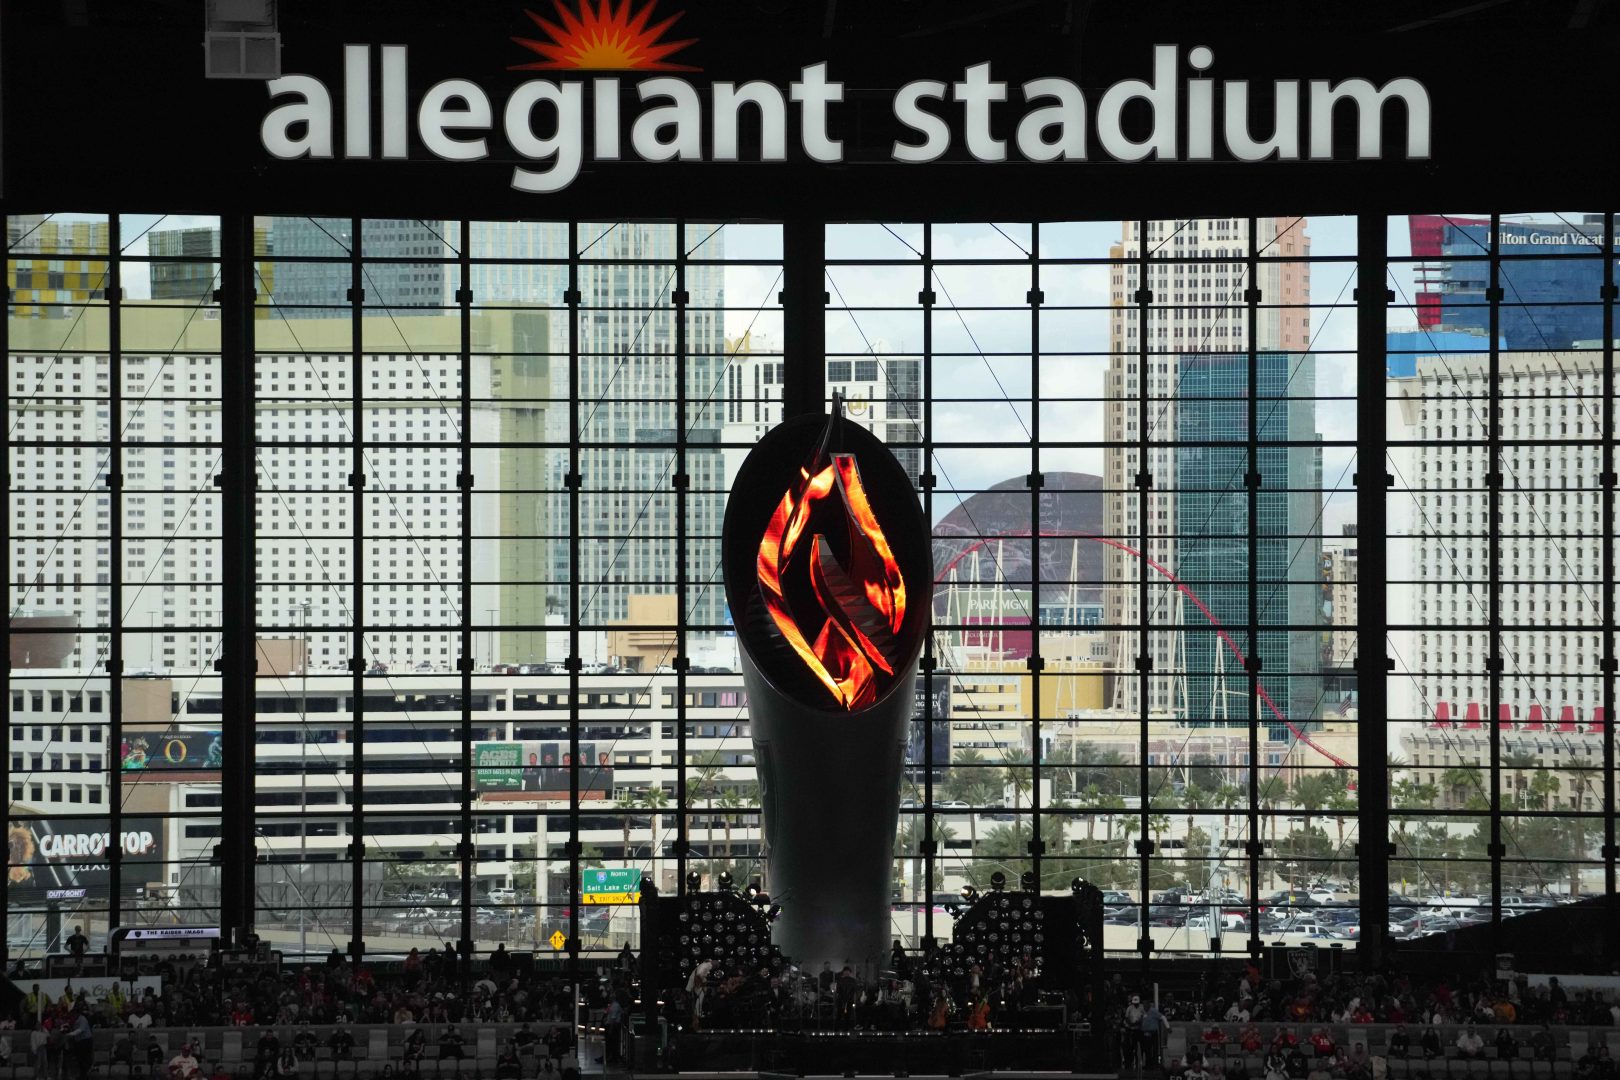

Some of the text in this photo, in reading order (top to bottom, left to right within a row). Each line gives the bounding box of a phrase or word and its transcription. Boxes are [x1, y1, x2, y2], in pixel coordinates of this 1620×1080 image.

[260, 43, 1433, 194] allegiant stadium
[1530, 232, 1568, 245] Grand
[969, 599, 1030, 610] PARK MGM
[623, 884, 638, 893] City
